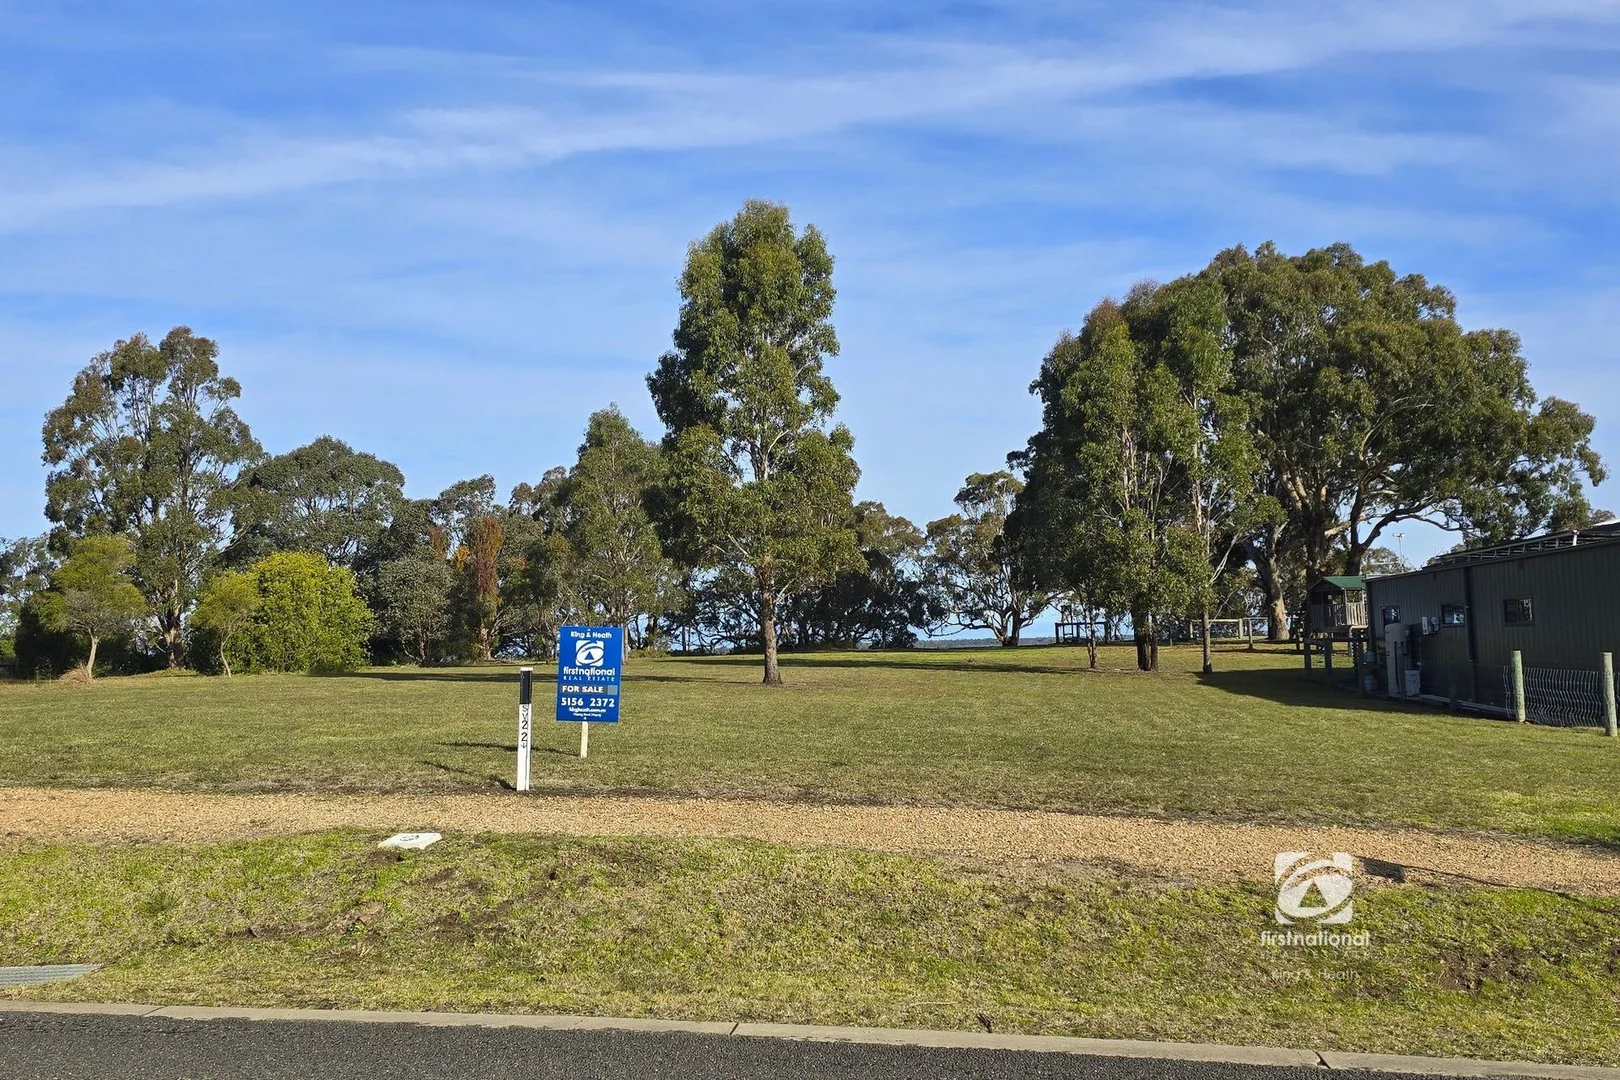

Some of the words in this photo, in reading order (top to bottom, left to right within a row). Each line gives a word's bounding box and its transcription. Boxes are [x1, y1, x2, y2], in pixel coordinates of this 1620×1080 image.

[570, 631, 585, 639] King
[592, 631, 612, 639] Heath
[563, 666, 615, 676] firstnational
[562, 685, 579, 693] FOR
[561, 697, 583, 706] 5156
[590, 698, 614, 707] 2372
